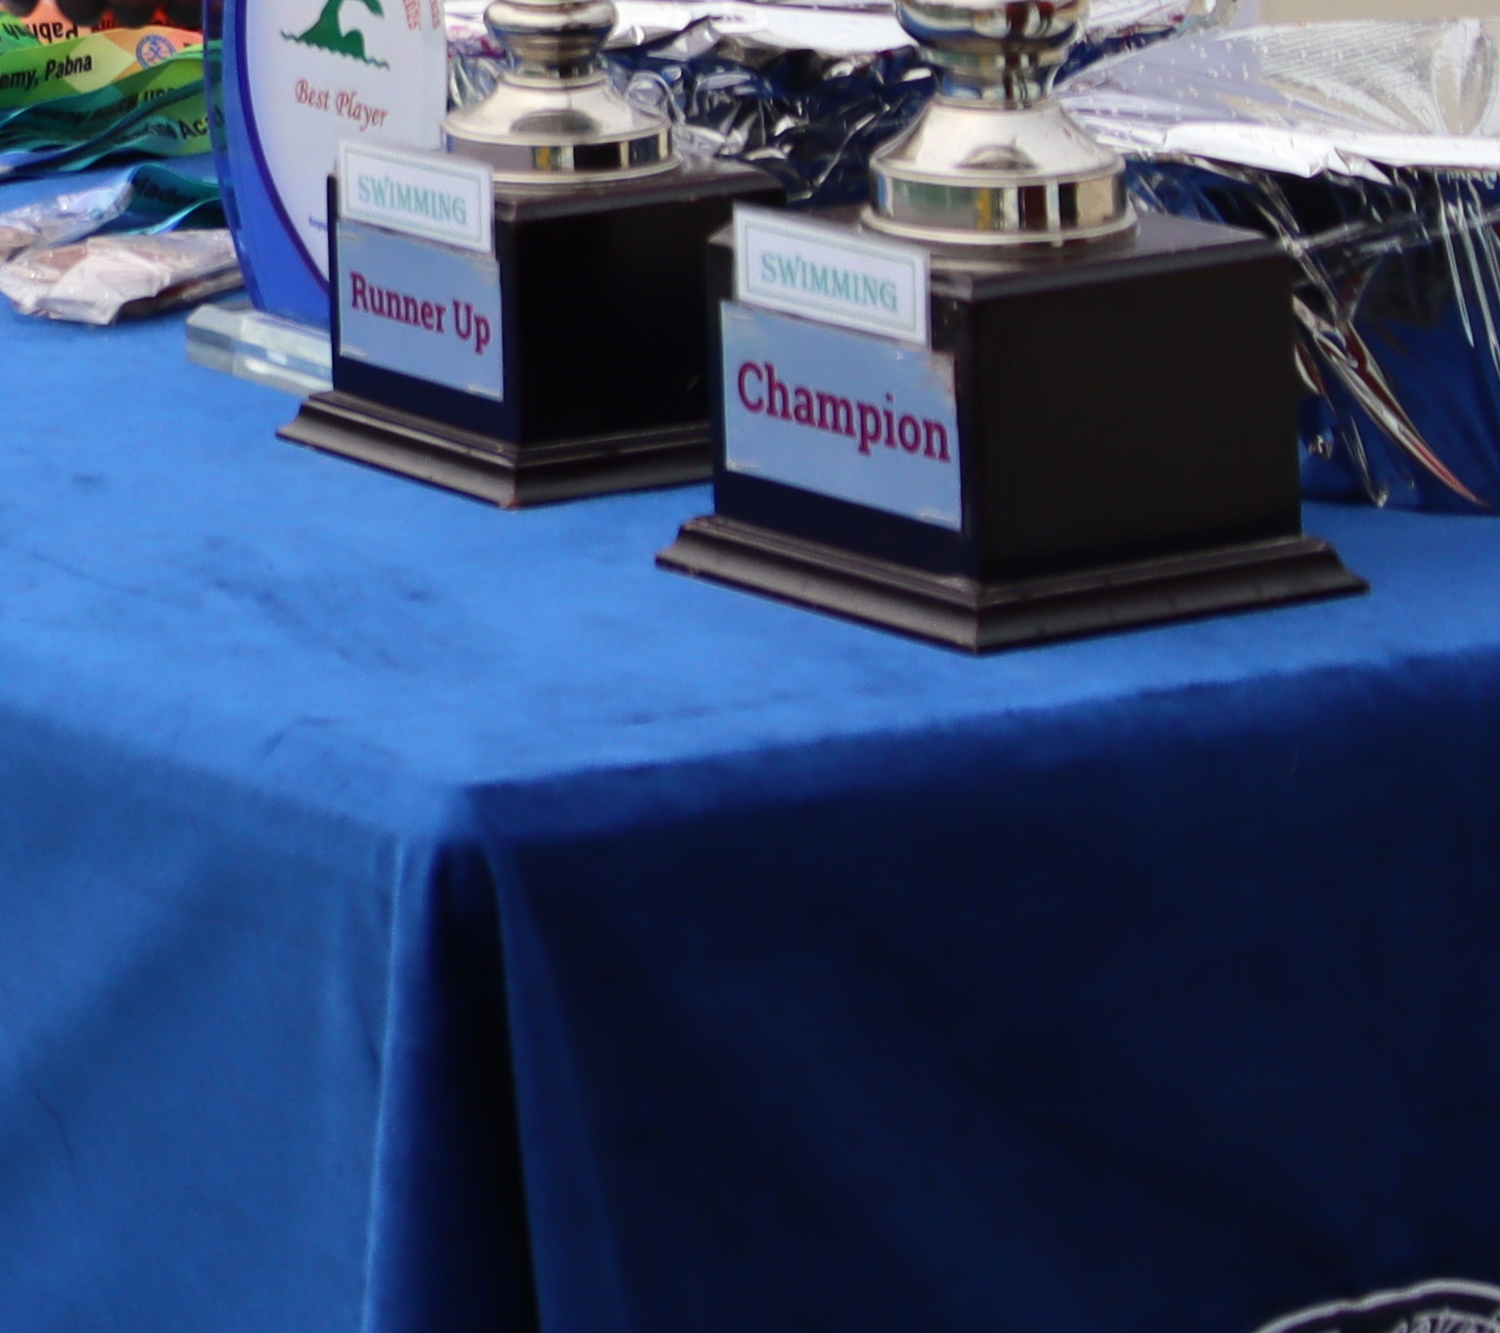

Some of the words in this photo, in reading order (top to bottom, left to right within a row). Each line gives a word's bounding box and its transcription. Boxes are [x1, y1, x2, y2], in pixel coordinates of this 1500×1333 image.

[44, 53, 93, 81] Pabna
[294, 77, 330, 112] Best
[335, 89, 390, 133] Player
[357, 172, 469, 225] SWIMMING
[760, 250, 899, 312] SWIMMING
[350, 271, 447, 334] Runner
[452, 299, 492, 355] Up
[736, 359, 952, 464] Champion
